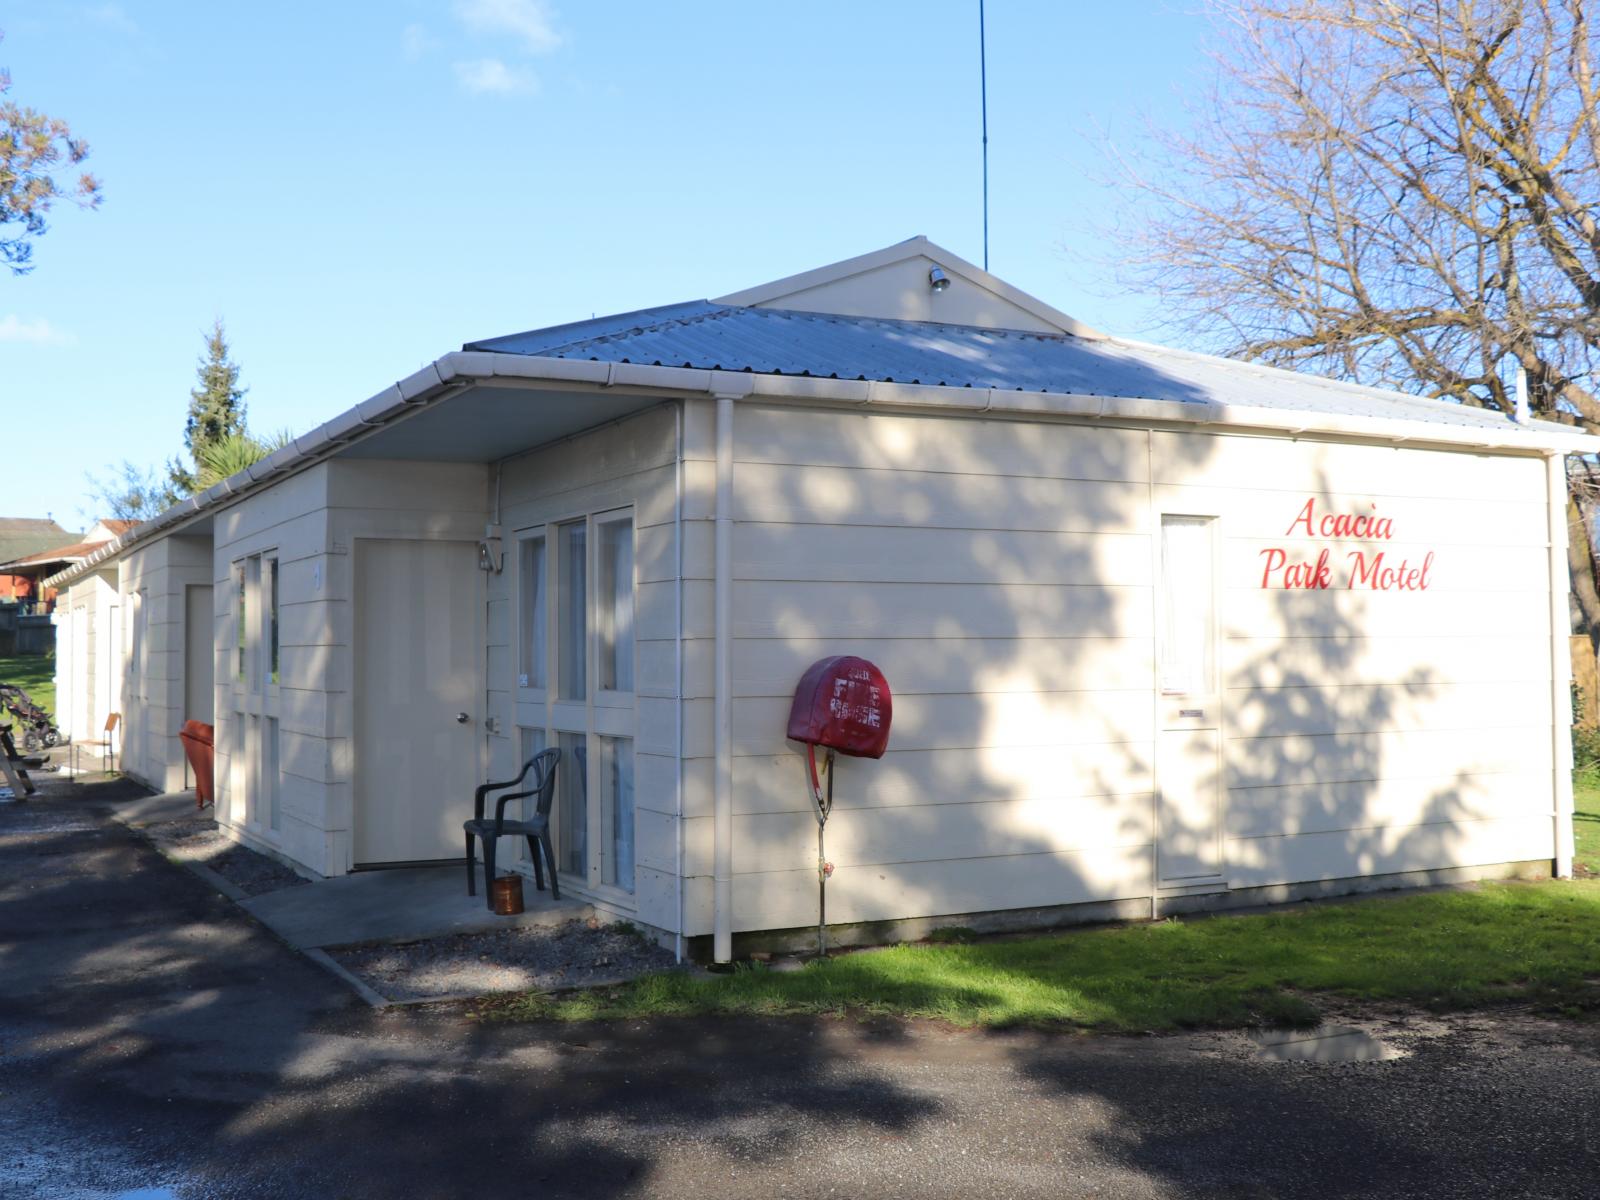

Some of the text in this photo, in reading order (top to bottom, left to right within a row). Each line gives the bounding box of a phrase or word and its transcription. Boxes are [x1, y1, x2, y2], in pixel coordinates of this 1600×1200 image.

[1286, 497, 1393, 540] Acacia
[1259, 548, 1435, 591] Park Motel
